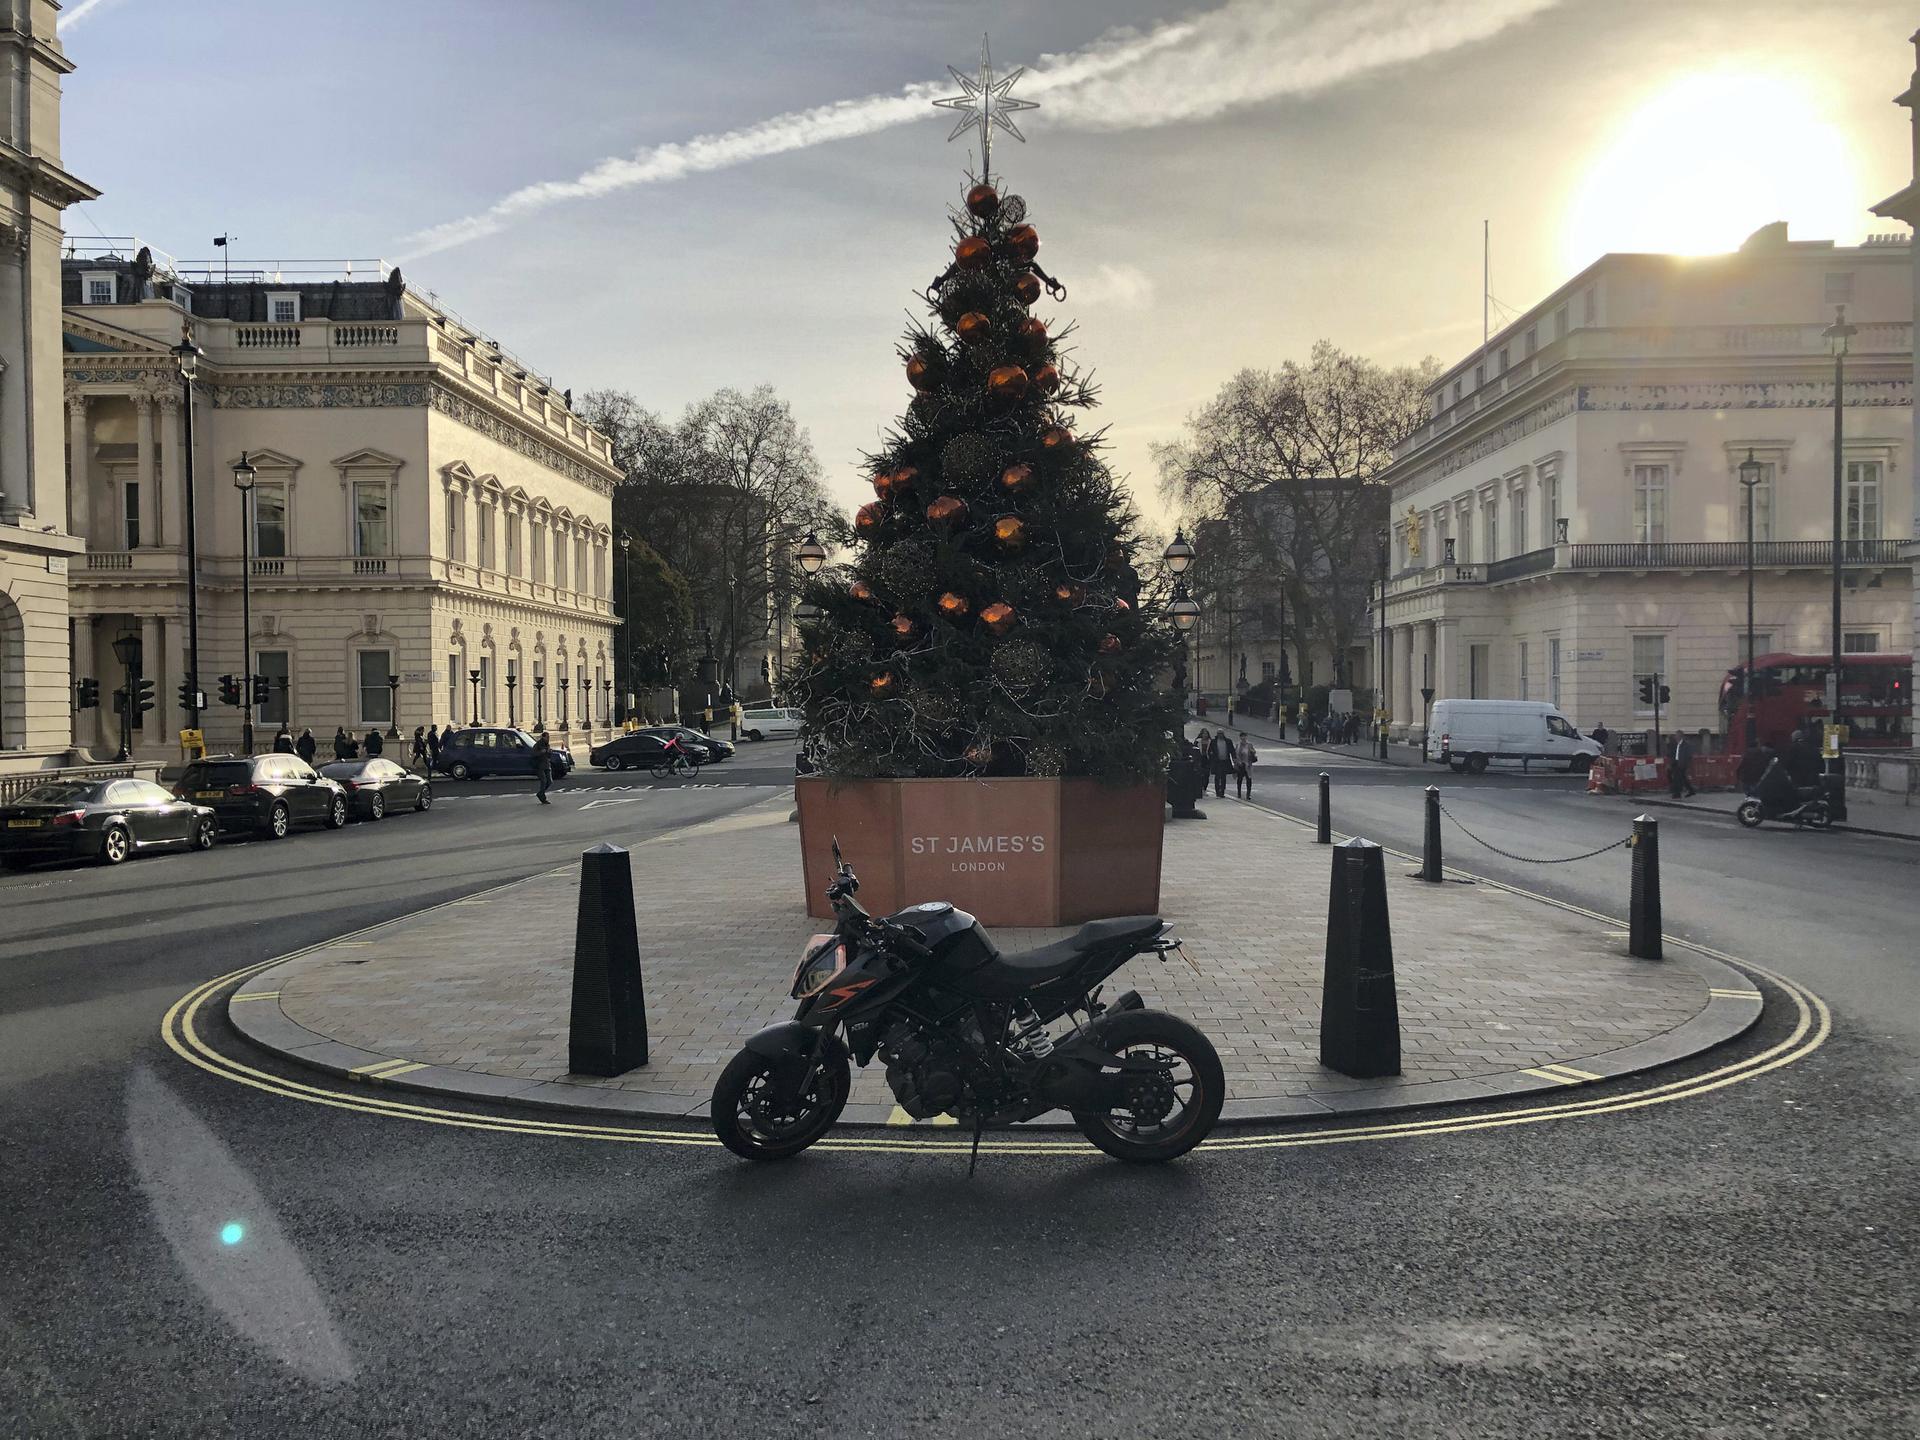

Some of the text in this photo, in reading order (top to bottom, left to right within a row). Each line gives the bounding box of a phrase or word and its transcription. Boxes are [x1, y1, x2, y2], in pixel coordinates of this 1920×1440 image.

[911, 835, 1045, 854] ST JAMES'S
[951, 861, 1006, 872] LONDON
